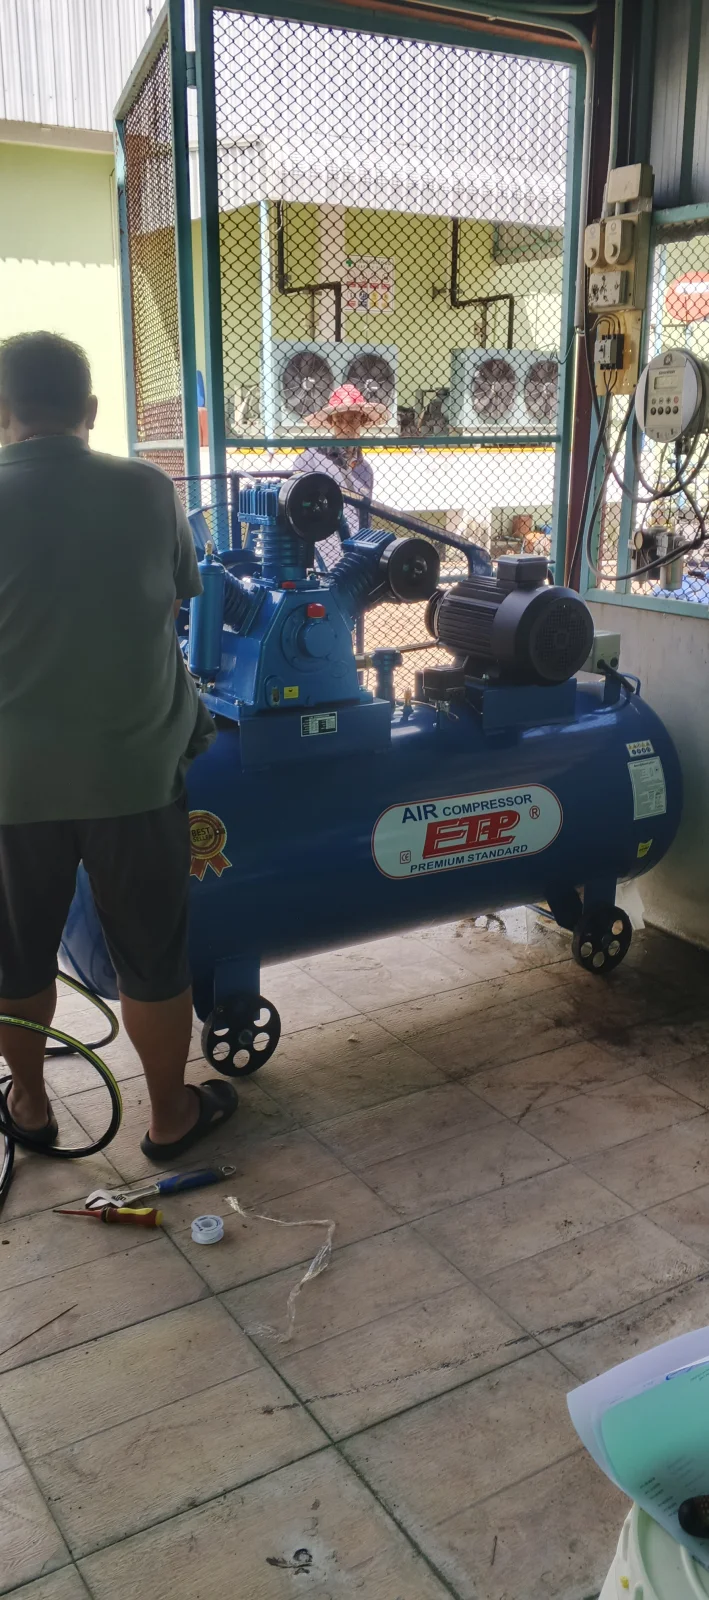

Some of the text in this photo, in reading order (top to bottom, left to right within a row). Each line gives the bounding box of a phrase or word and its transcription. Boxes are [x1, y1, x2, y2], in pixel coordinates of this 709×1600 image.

[401, 794, 533, 824] AIR COMPRESSOR
[191, 827, 210, 837] BEST
[192, 834, 214, 843] SELLER
[410, 844, 528, 873] PREMIUM STANDARD
